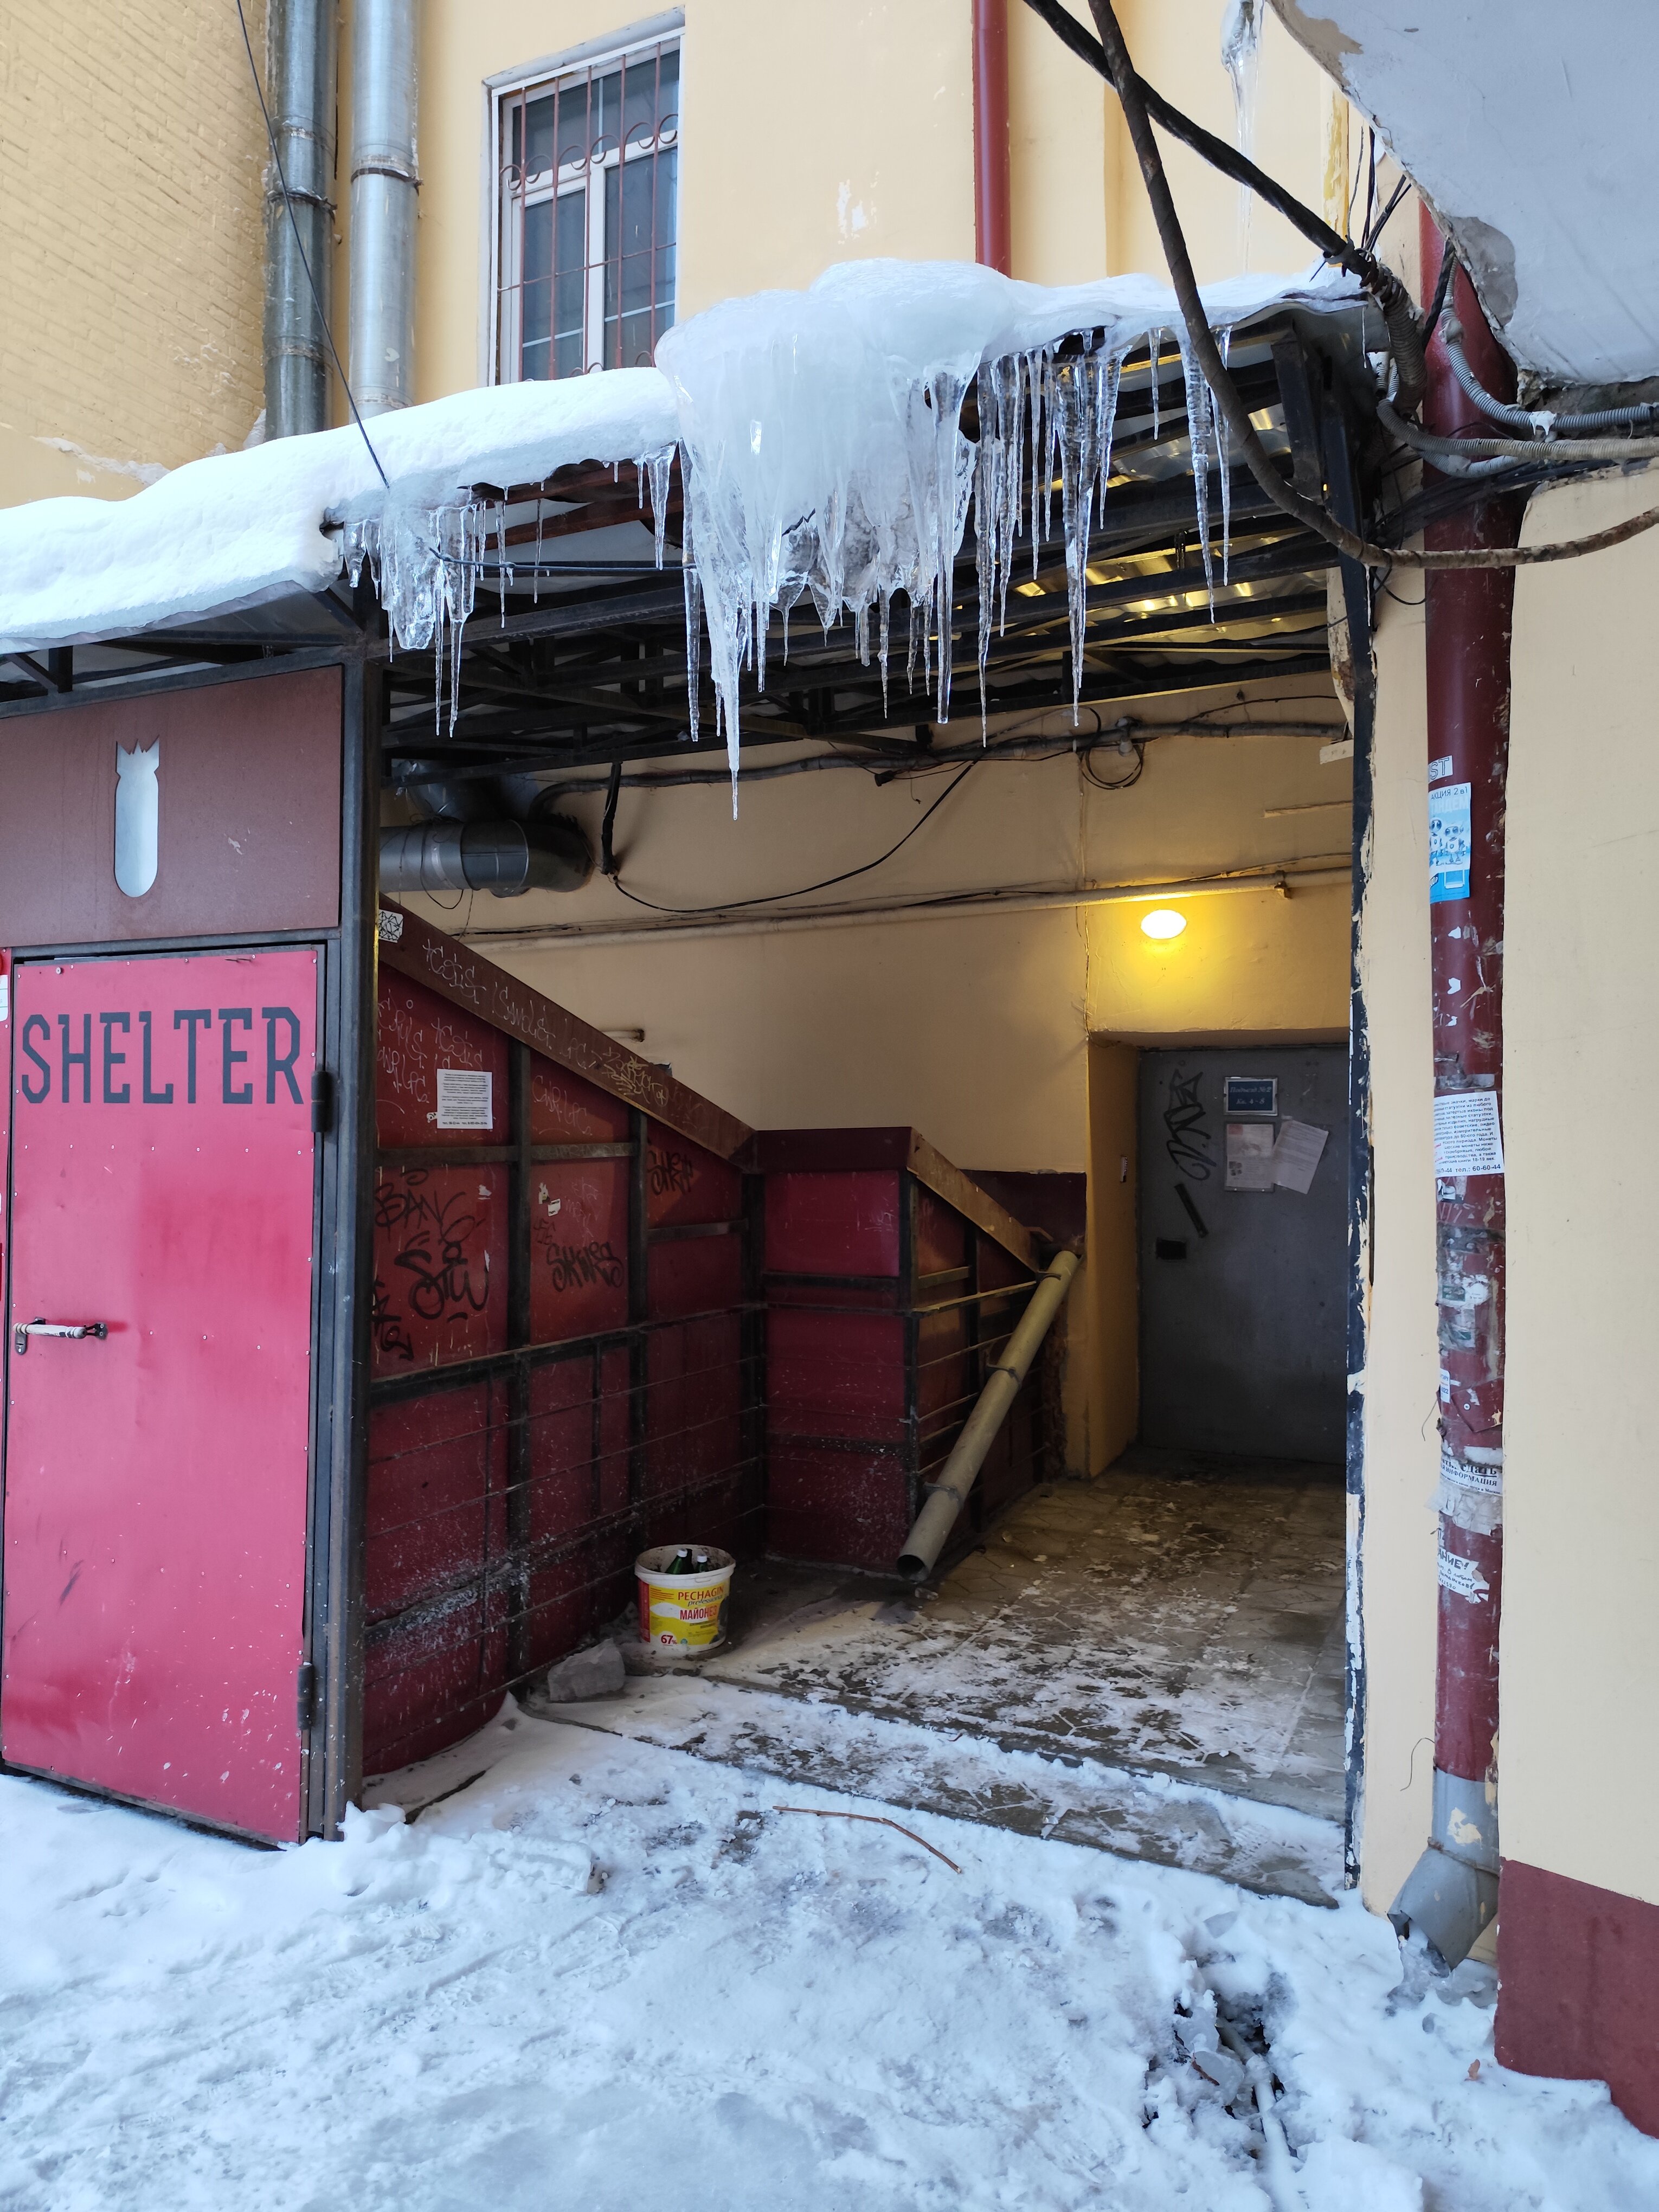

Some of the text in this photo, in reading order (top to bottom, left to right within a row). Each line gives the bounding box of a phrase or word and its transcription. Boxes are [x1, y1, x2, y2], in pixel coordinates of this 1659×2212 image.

[1430, 757, 1450, 780] ST
[1431, 789, 1451, 800] АКЦИЯ
[1454, 787, 1458, 795] 2
[22, 1006, 304, 1104] SHELTER
[1445, 1465, 1497, 1487] ИНФОРМАЦИЯ
[678, 1586, 724, 1600] PECHAGIN
[680, 1605, 717, 1620] МАЙОНЕЗ
